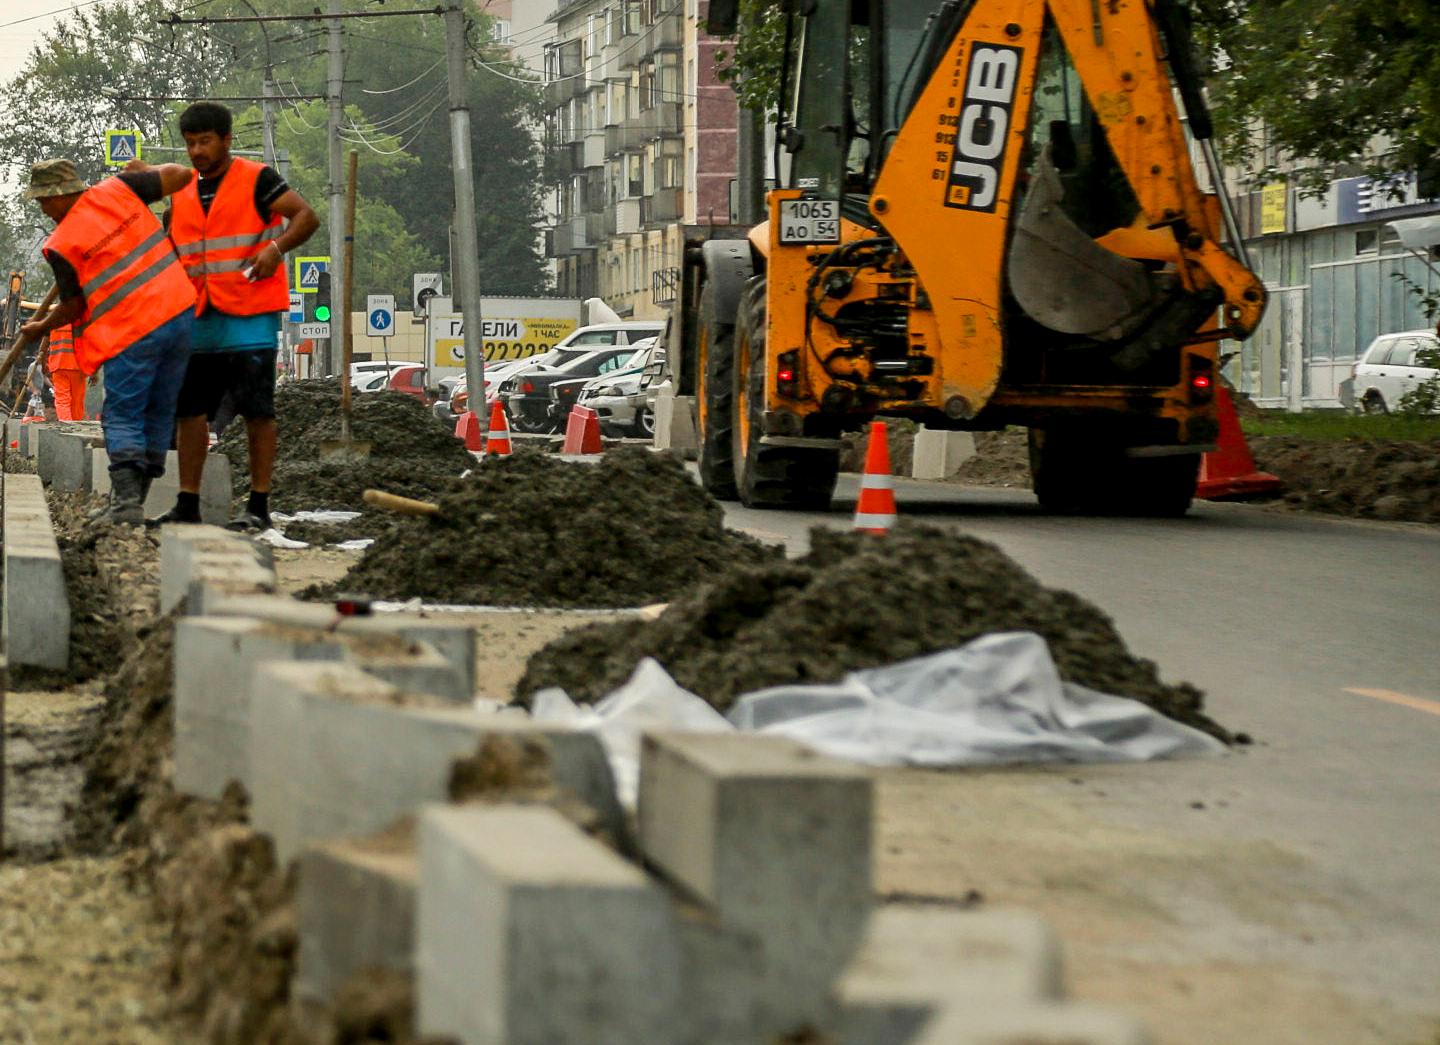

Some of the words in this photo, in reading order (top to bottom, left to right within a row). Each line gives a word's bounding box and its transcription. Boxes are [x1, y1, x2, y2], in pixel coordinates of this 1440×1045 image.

[954, 48, 1018, 207] JCB
[790, 202, 832, 218] 1065
[785, 226, 808, 238] АО
[817, 221, 836, 234] 54
[302, 326, 328, 335] СТОП
[450, 322, 518, 337] ГАЕЛИ
[534, 329, 538, 338] 1
[541, 329, 560, 338] ЧАС
